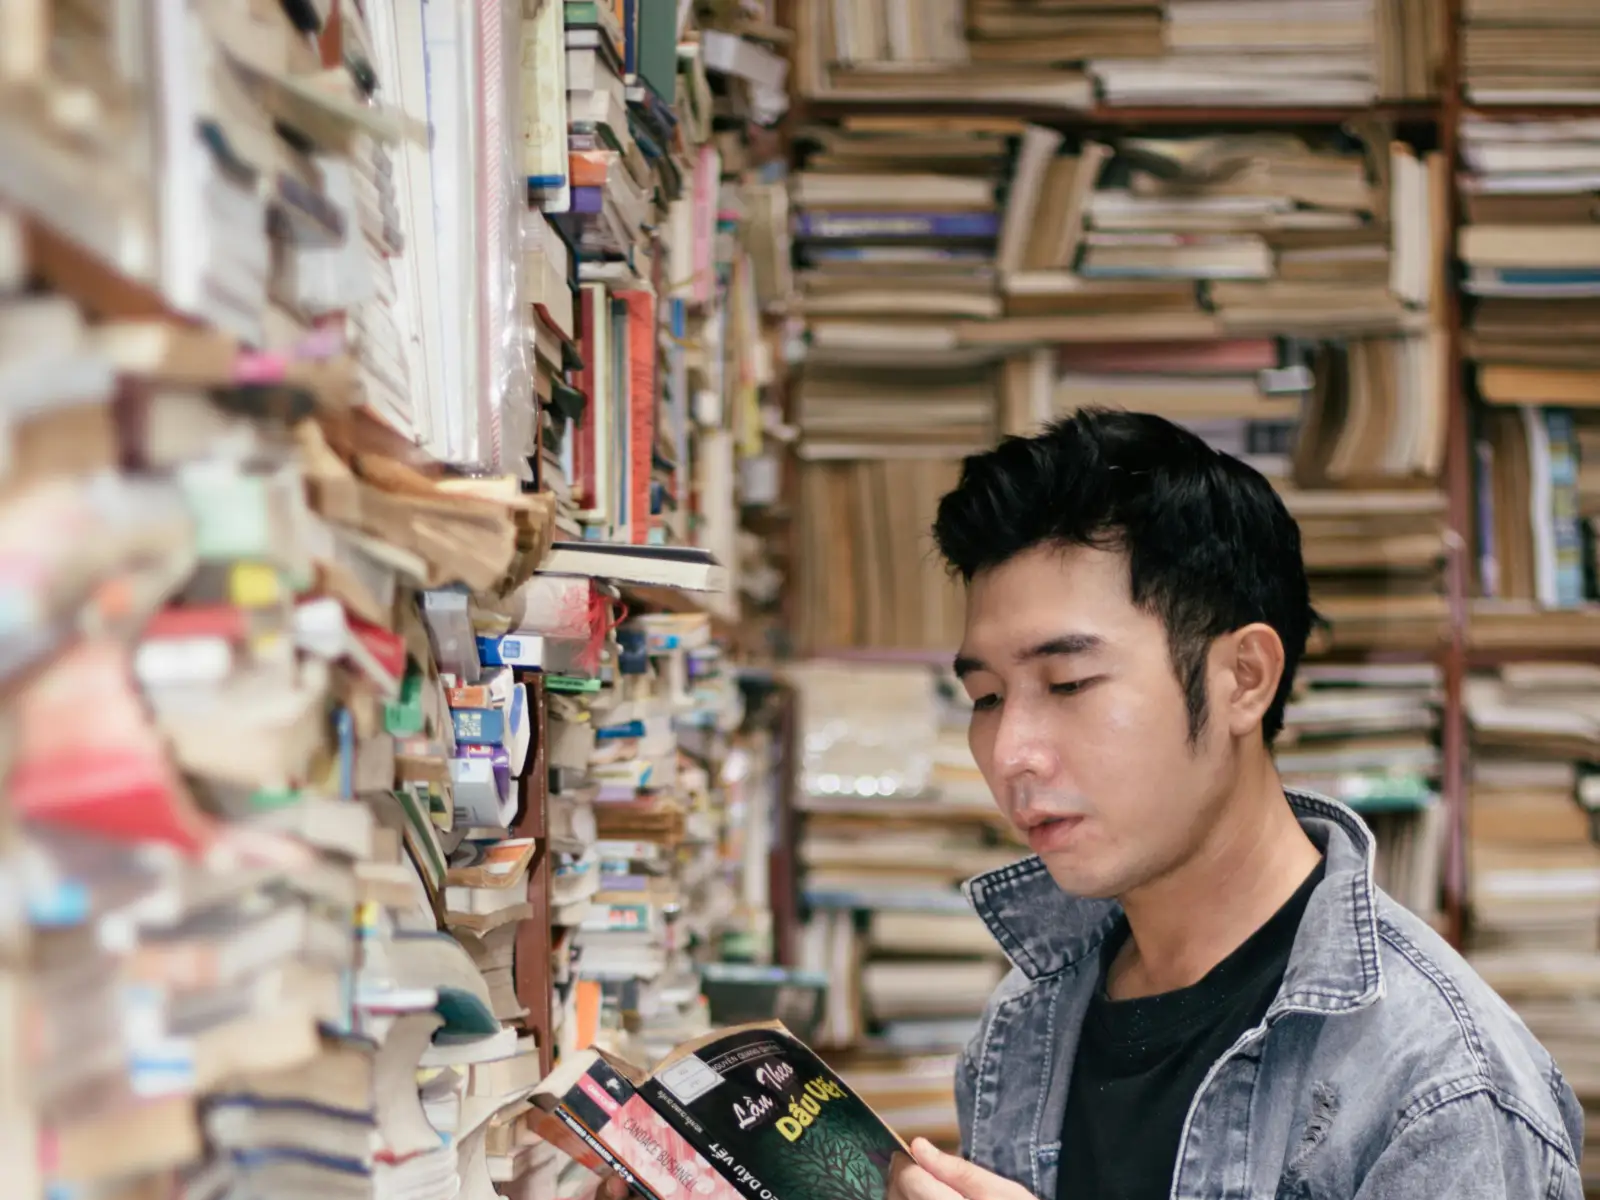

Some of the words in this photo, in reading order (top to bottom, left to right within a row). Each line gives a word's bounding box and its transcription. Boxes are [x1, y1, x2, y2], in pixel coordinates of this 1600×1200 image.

[733, 1093, 773, 1129] Lần
[756, 1062, 794, 1091] Theo
[775, 1095, 821, 1142] Dấu
[622, 1117, 662, 1156] CANDACE
[656, 1150, 699, 1192] BUSHNELL
[708, 1142, 736, 1167] VẾT
[732, 1163, 762, 1190] DẤU
